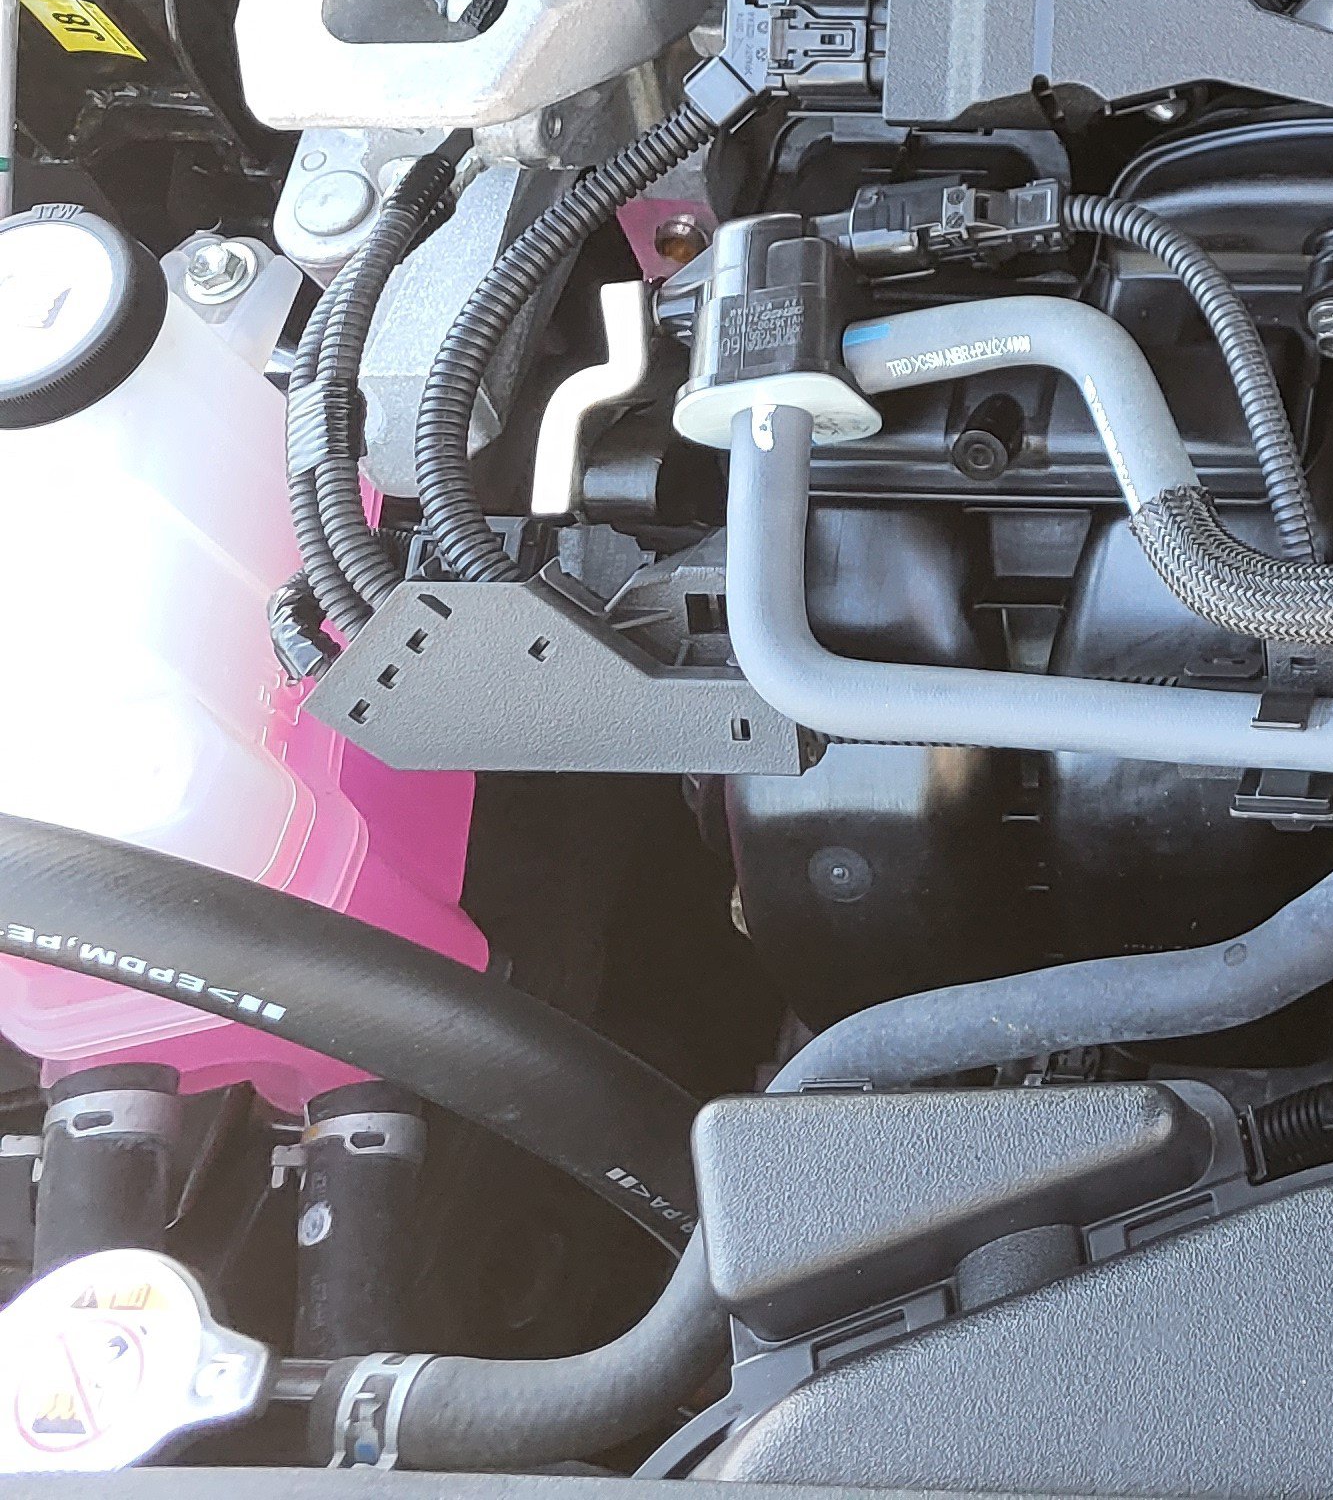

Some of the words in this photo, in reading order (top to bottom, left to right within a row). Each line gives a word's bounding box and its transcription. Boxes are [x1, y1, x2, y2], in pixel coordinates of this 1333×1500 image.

[51, 12, 106, 42] J8
[35, 204, 80, 220] ITW
[0, 923, 240, 1004] >EPDM,PE
